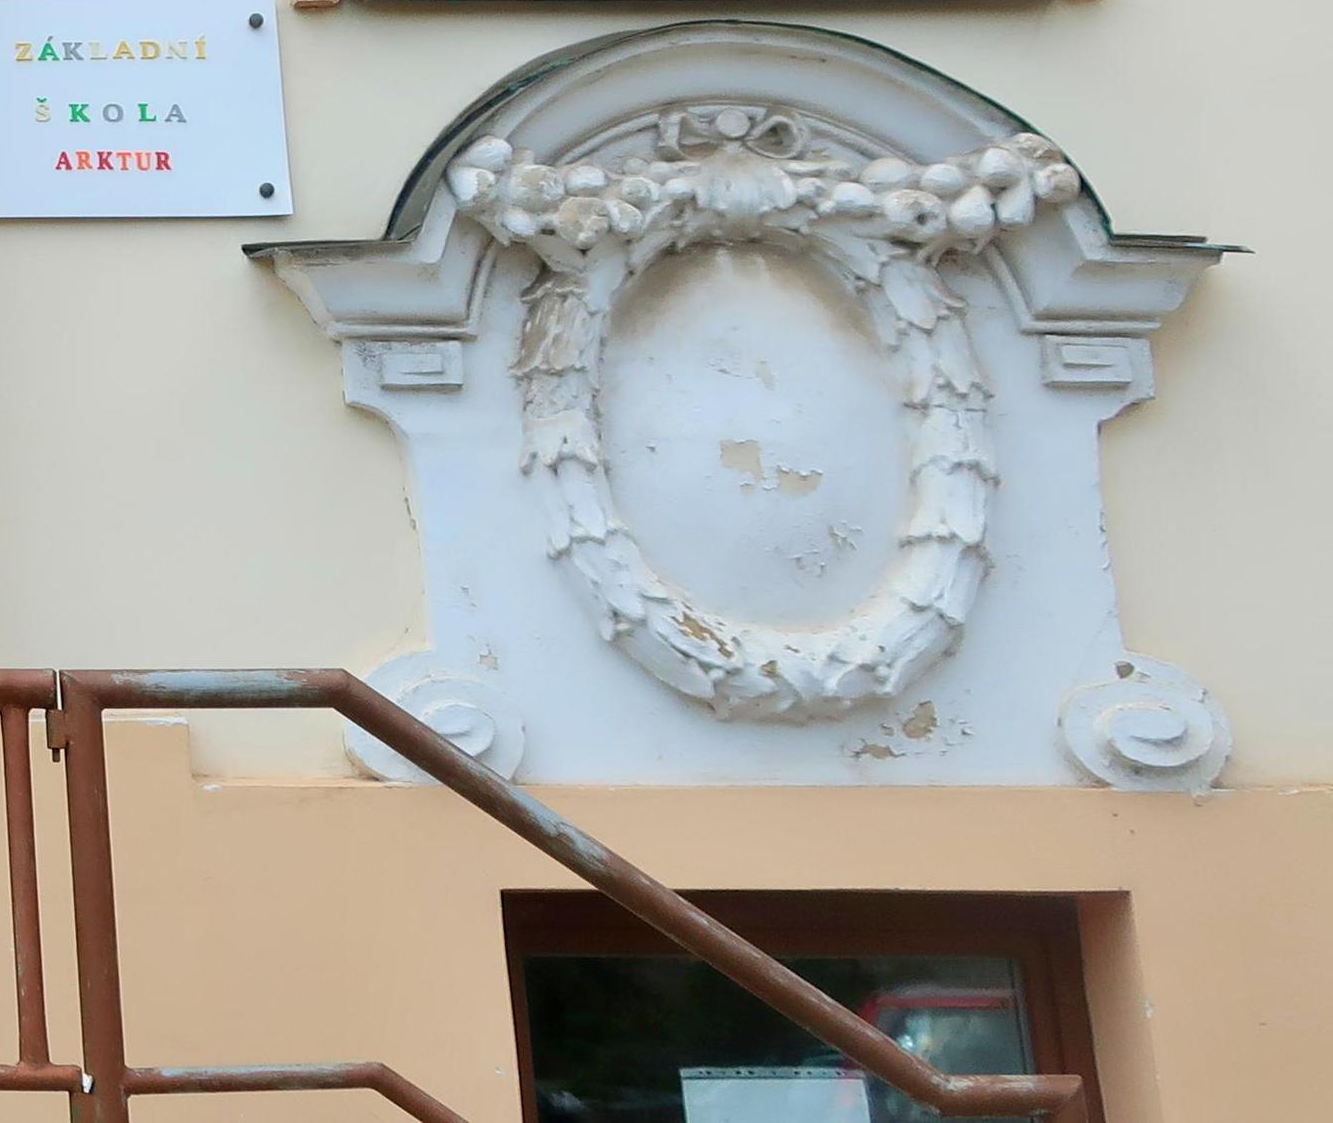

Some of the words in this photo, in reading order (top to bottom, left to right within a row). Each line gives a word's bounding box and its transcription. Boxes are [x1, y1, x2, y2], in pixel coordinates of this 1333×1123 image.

[15, 35, 208, 62] ZÁKLADNÍ
[35, 97, 187, 123] ŠKOLA
[55, 151, 173, 171] ARKTUR
